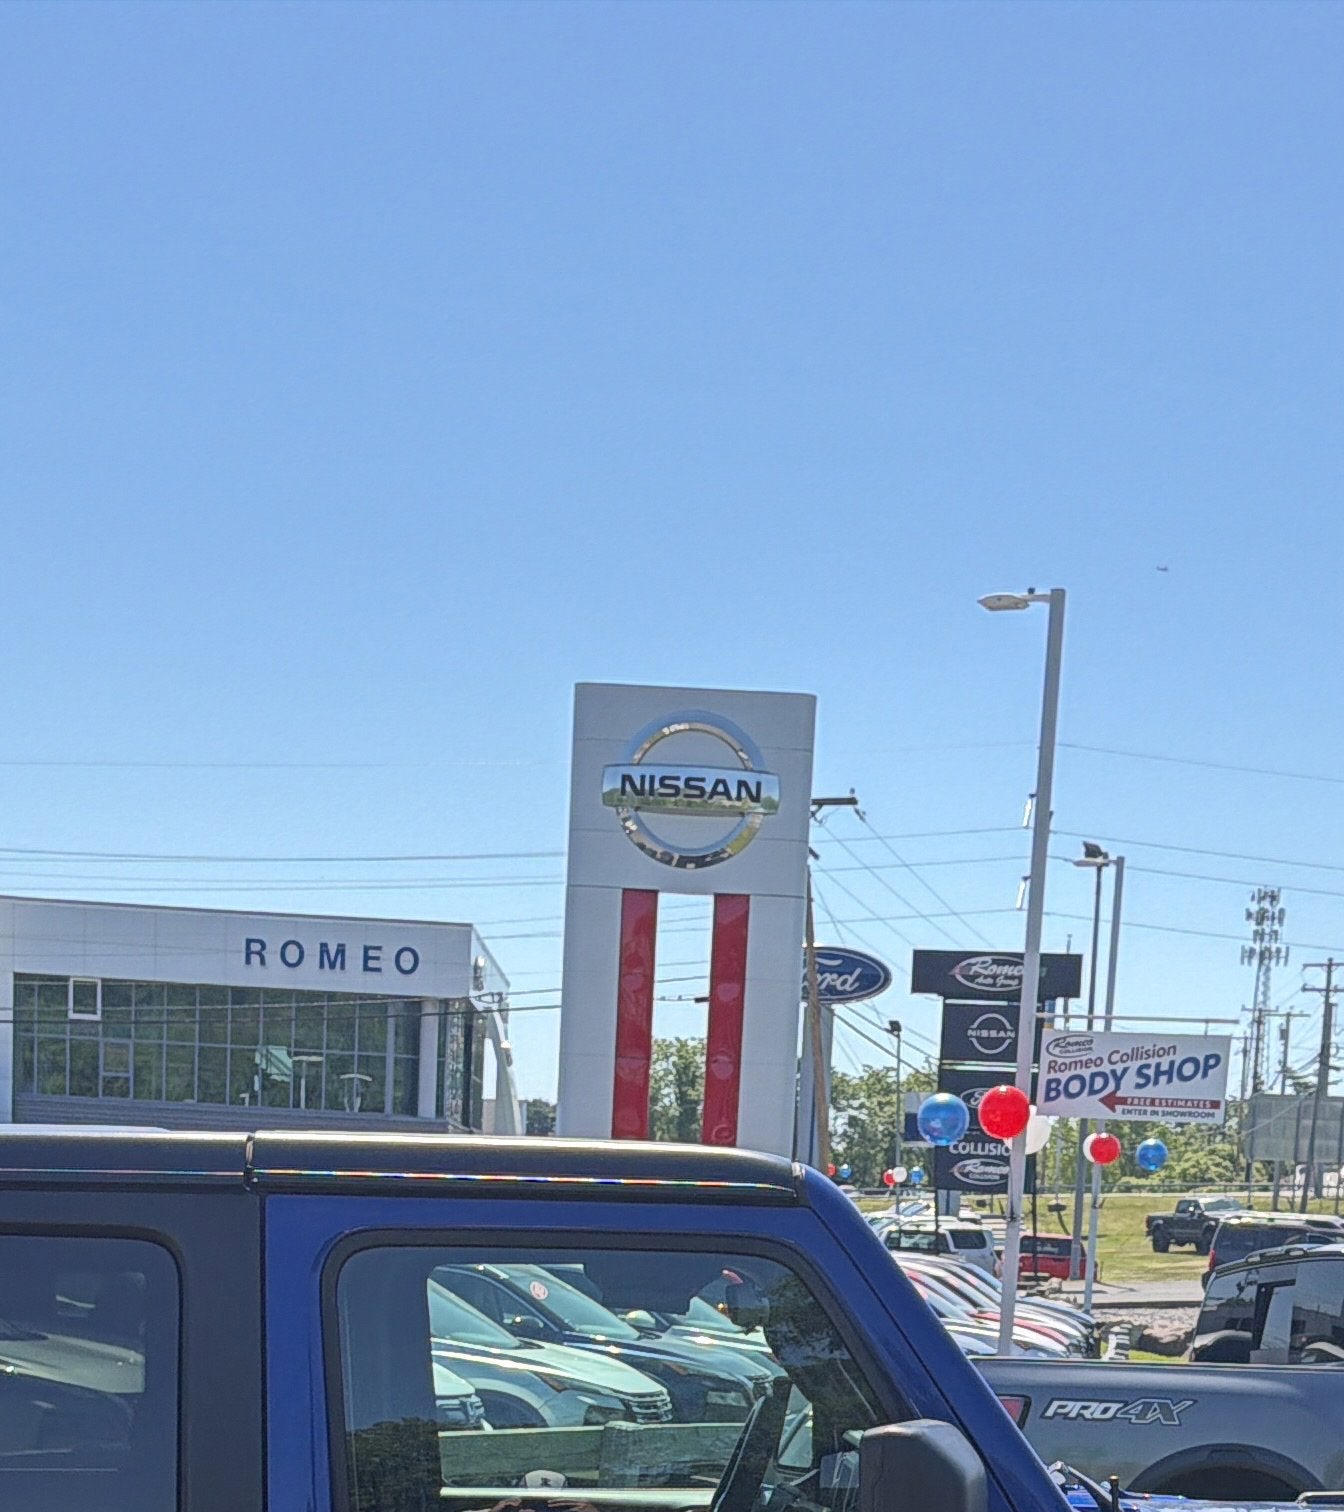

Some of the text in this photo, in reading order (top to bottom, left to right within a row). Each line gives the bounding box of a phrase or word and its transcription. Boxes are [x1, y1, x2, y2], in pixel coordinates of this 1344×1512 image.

[620, 773, 762, 803] NISSAN
[244, 937, 420, 976] ROMEO
[968, 959, 1023, 976] Rome
[967, 1029, 1016, 1038] NISSAN
[1047, 1044, 1177, 1074] Romeo Collision
[1044, 1053, 1222, 1103] BODY SHOP
[1126, 1097, 1212, 1108] FREE ESTIMATES
[1121, 1108, 1148, 1116] ENTER
[1161, 1109, 1215, 1118] SHOWROOM
[949, 1141, 1010, 1156] COLLISIO
